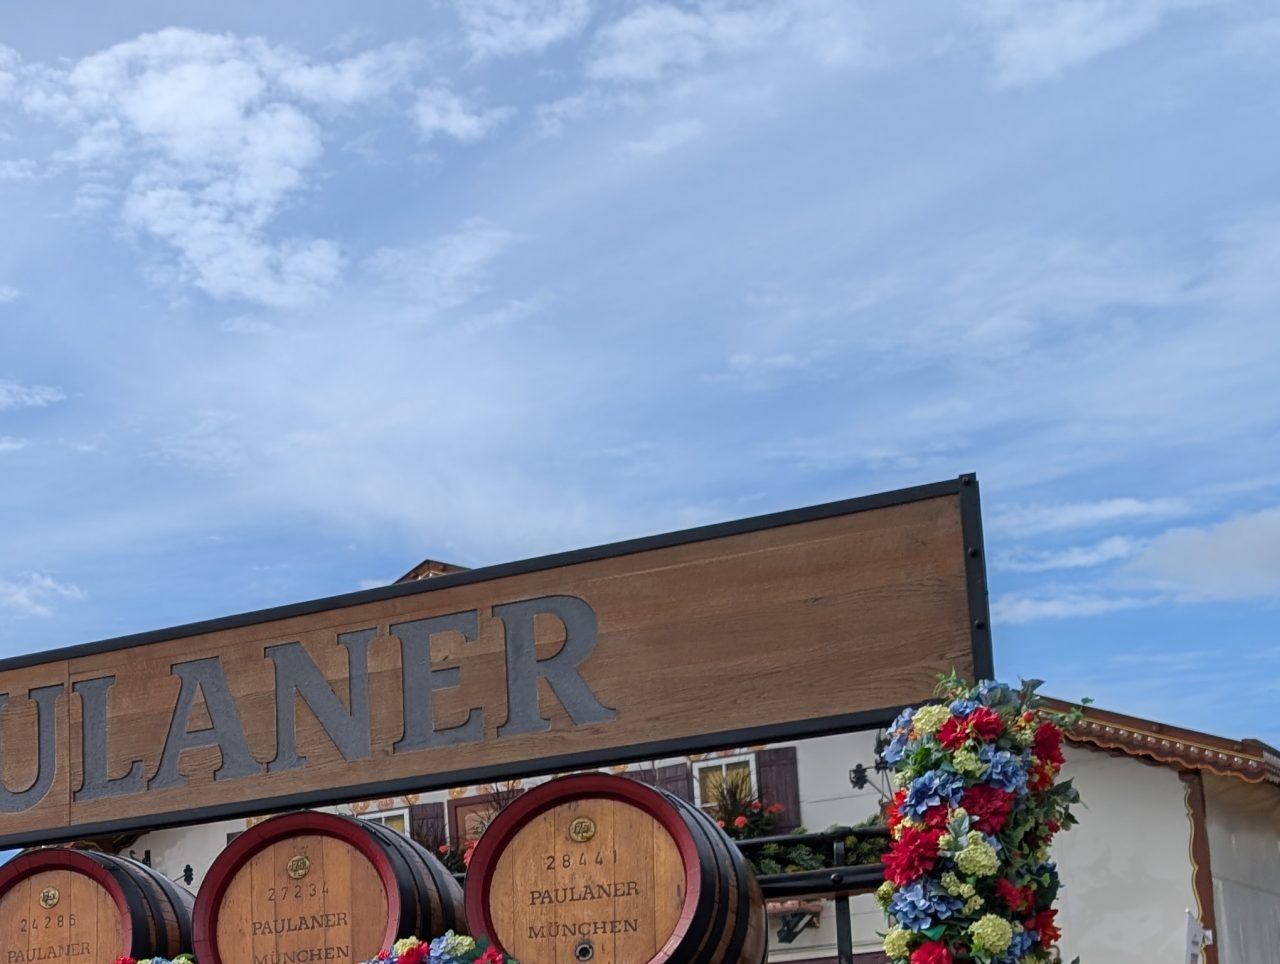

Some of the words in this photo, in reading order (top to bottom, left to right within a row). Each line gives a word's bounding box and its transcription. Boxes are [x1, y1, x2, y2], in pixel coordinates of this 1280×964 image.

[545, 849, 617, 871] 28441
[267, 881, 329, 902] 27234
[529, 881, 640, 906] PAULANER
[252, 912, 348, 936] PAULANER
[528, 919, 639, 939] MÜNCHEN
[7, 942, 91, 964] PAULANER
